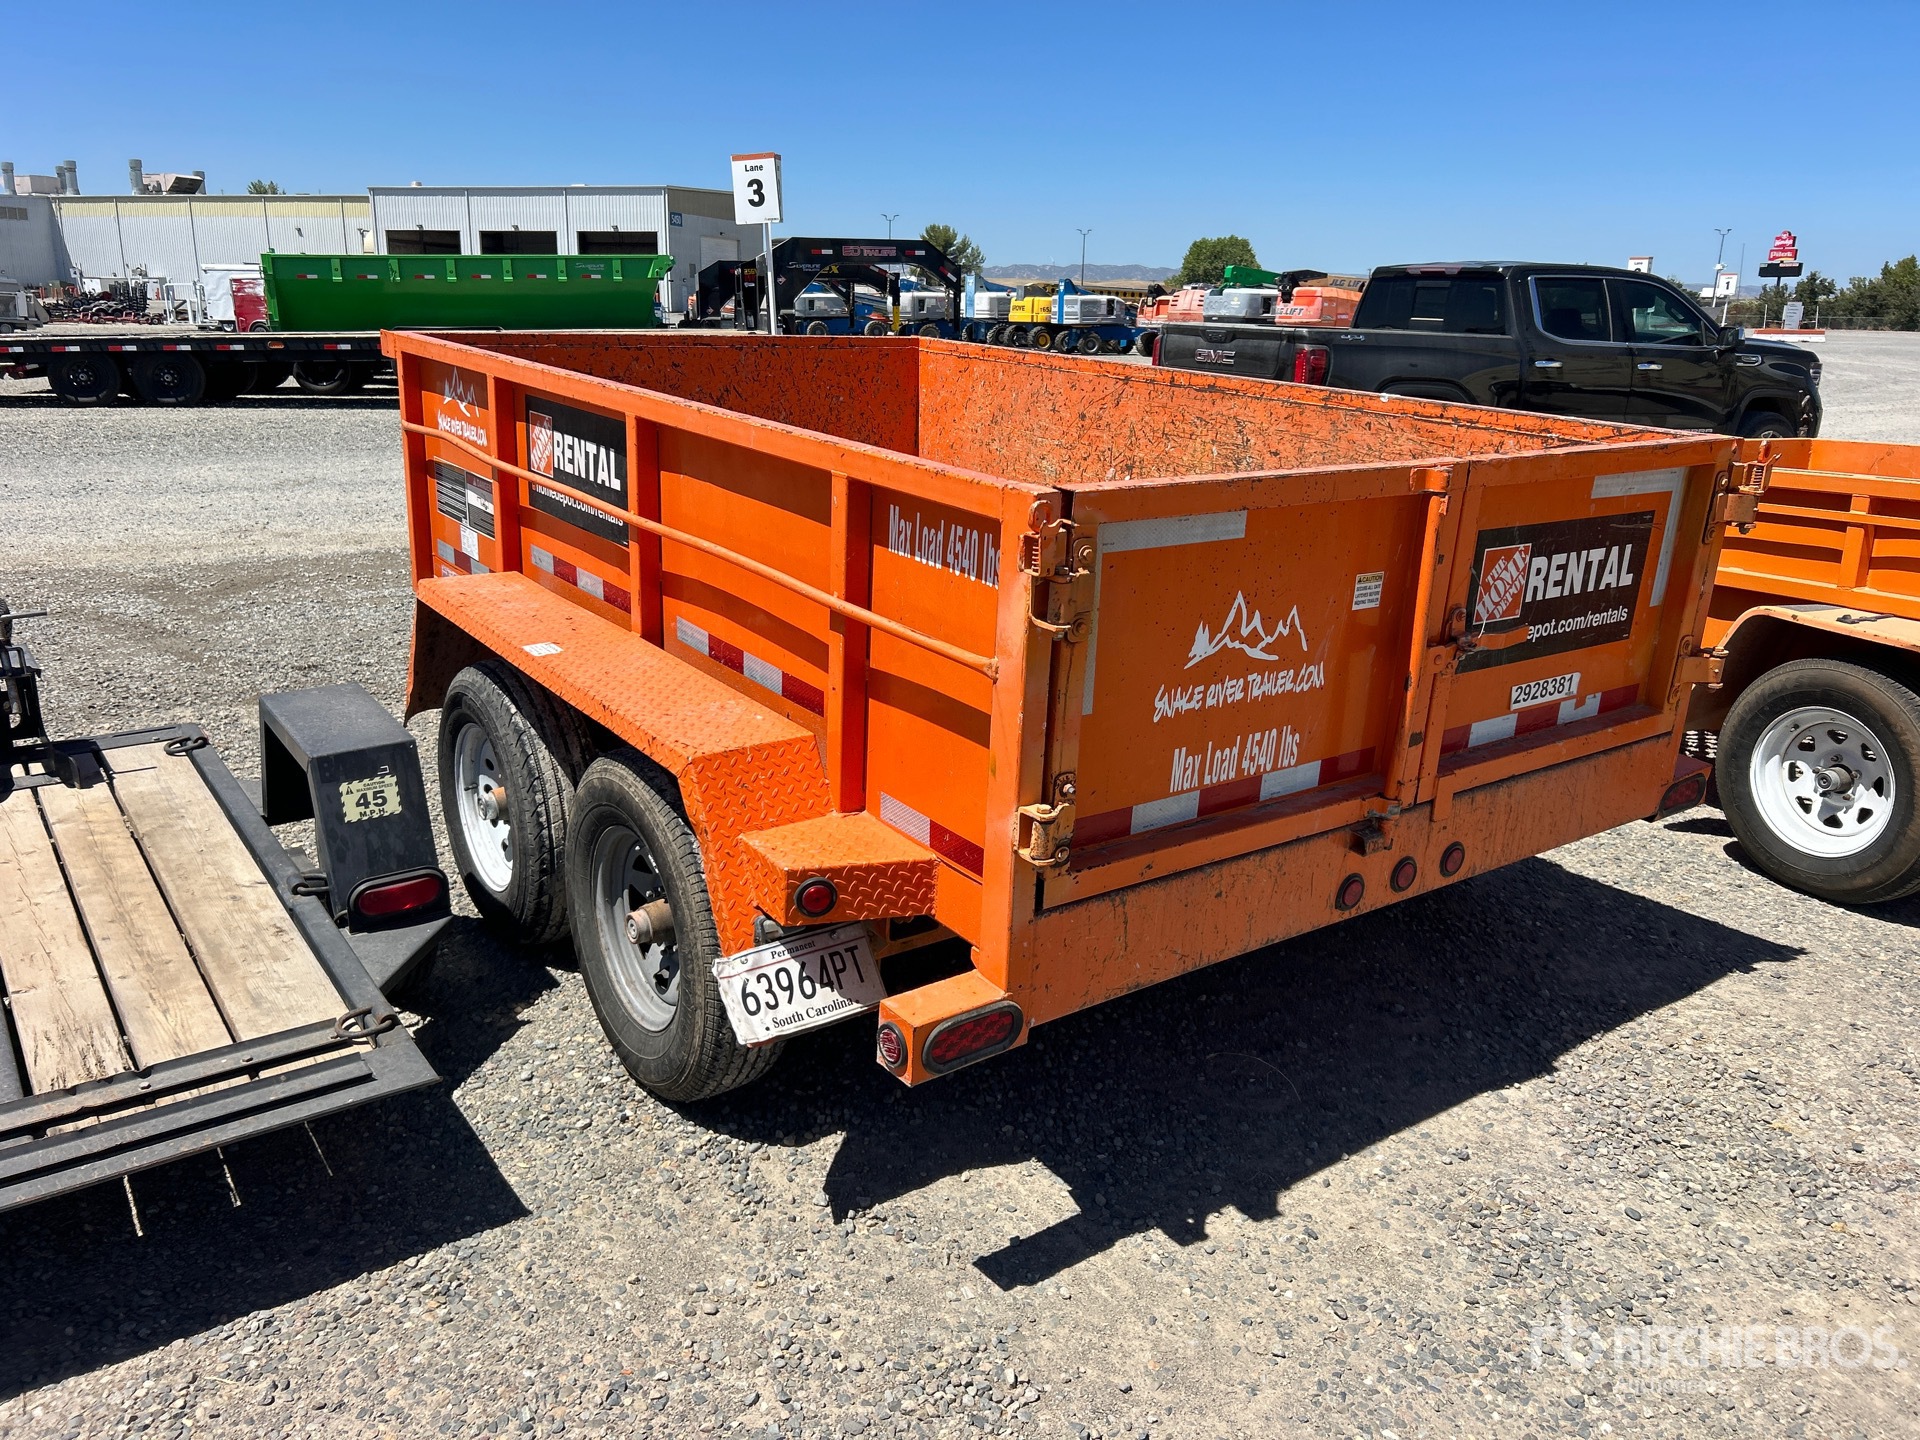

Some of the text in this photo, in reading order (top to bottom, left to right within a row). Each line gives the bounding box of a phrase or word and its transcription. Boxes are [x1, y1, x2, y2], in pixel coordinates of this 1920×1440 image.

[744, 164, 764, 172] Lane
[747, 178, 766, 208] 3
[1329, 279, 1346, 287] JLG
[1725, 281, 1731, 291] 1
[1285, 307, 1304, 316] LIFT
[1194, 348, 1236, 365] GMC
[553, 430, 621, 492] RENTAL
[888, 504, 1000, 590] Max Load 4540 lbs
[1475, 545, 1530, 622] HOME
[1485, 555, 1508, 585] THE
[1525, 543, 1634, 603] RENTAL
[1493, 573, 1527, 619] DEPOT
[1526, 605, 1629, 643] epot.com/rentals
[1153, 661, 1325, 723] SNAKE RIVER TRAILER.COM
[1512, 674, 1574, 705] 2928381
[1169, 725, 1300, 793] Max Load 4540 lbs
[355, 789, 388, 809] 45
[356, 785, 378, 793] MAXIMUM
[359, 808, 388, 818] M.P.H.
[771, 940, 816, 960] Permanent
[741, 945, 865, 1017] 63964PT
[772, 998, 853, 1029] South Carolina
